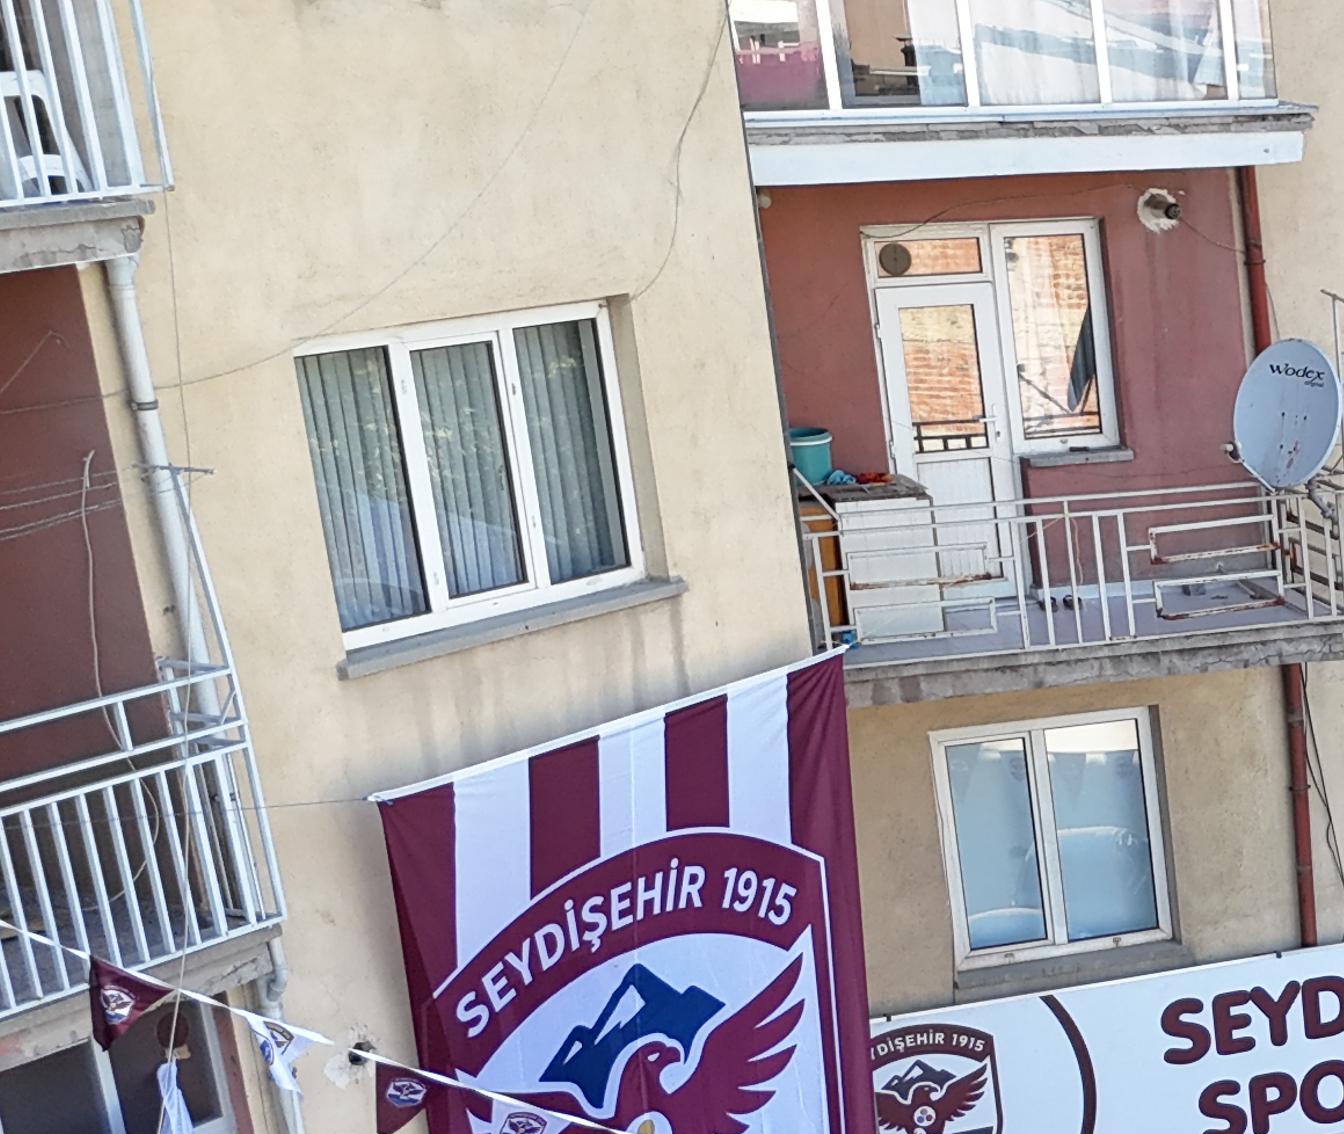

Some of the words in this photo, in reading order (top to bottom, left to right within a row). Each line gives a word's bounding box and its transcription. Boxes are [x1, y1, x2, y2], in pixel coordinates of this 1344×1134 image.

[455, 857, 707, 1039] SEYDİŞEHİR
[720, 866, 798, 926] 1915
[870, 1029, 945, 1060] DİŞEHİR
[951, 1033, 985, 1052] 1915
